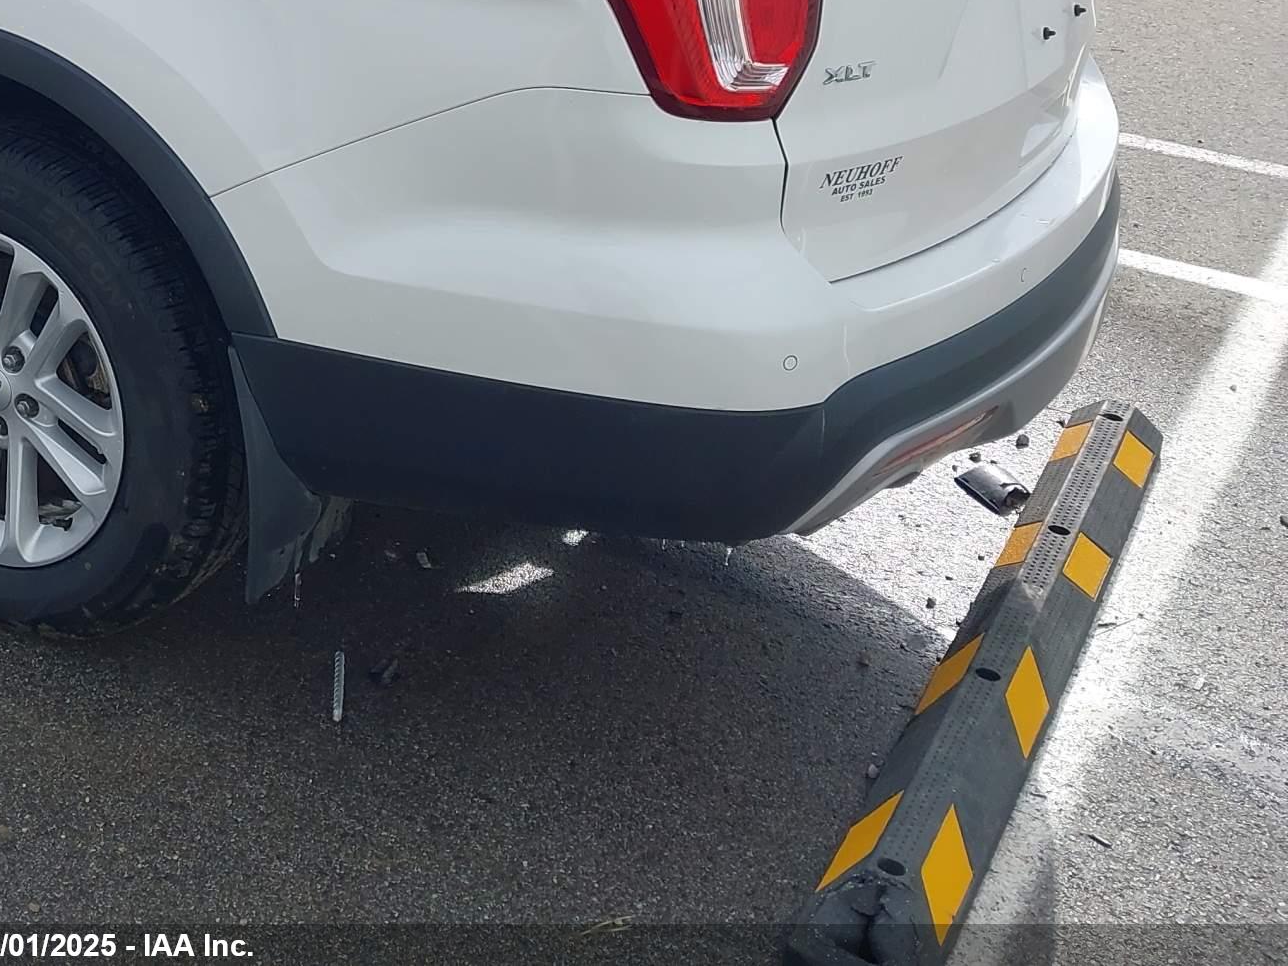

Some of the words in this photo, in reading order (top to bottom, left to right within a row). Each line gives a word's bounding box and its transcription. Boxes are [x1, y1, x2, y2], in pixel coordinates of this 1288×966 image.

[822, 60, 876, 85] XLT
[819, 156, 903, 189] NEUHOFF
[831, 183, 857, 196] AUTO
[859, 176, 886, 190] SALES
[840, 193, 854, 203] EST
